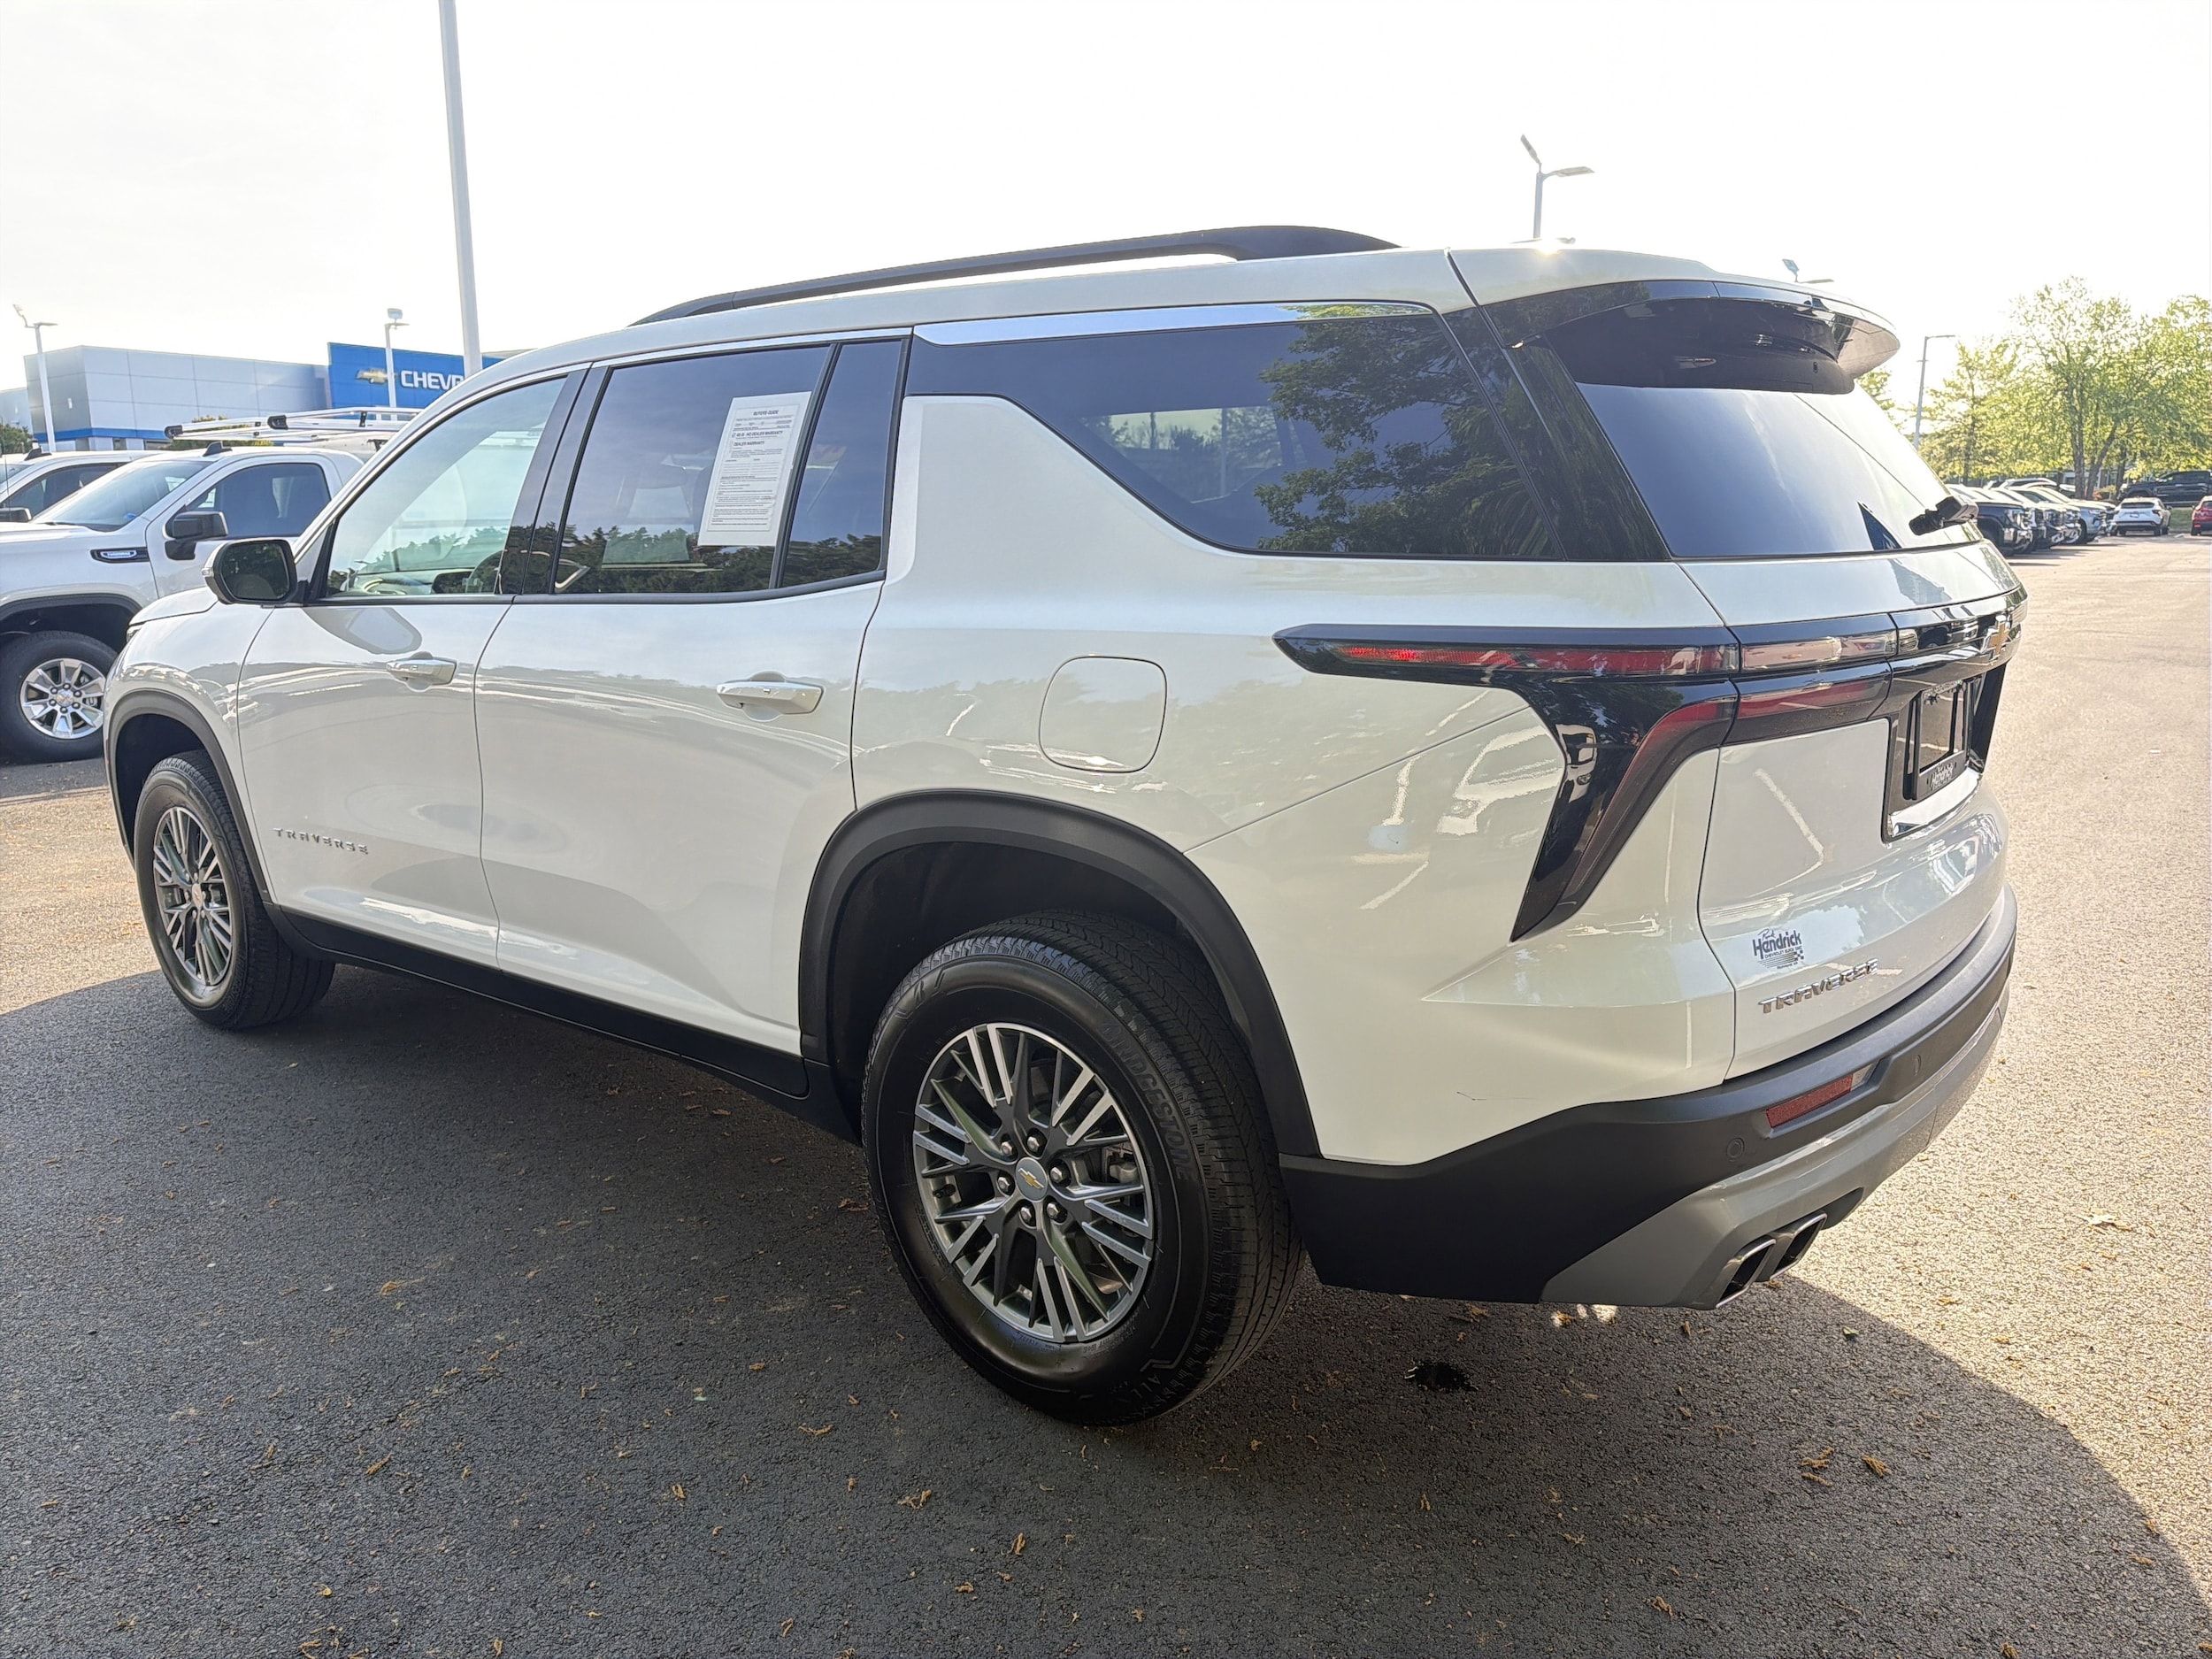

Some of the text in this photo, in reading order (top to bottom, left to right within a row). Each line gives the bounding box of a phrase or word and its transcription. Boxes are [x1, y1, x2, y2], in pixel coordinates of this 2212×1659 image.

[273, 827, 368, 855] TRAVERSE
[1752, 930, 1801, 959] Hendrick
[1758, 958, 1878, 1014] TRAVERSE
